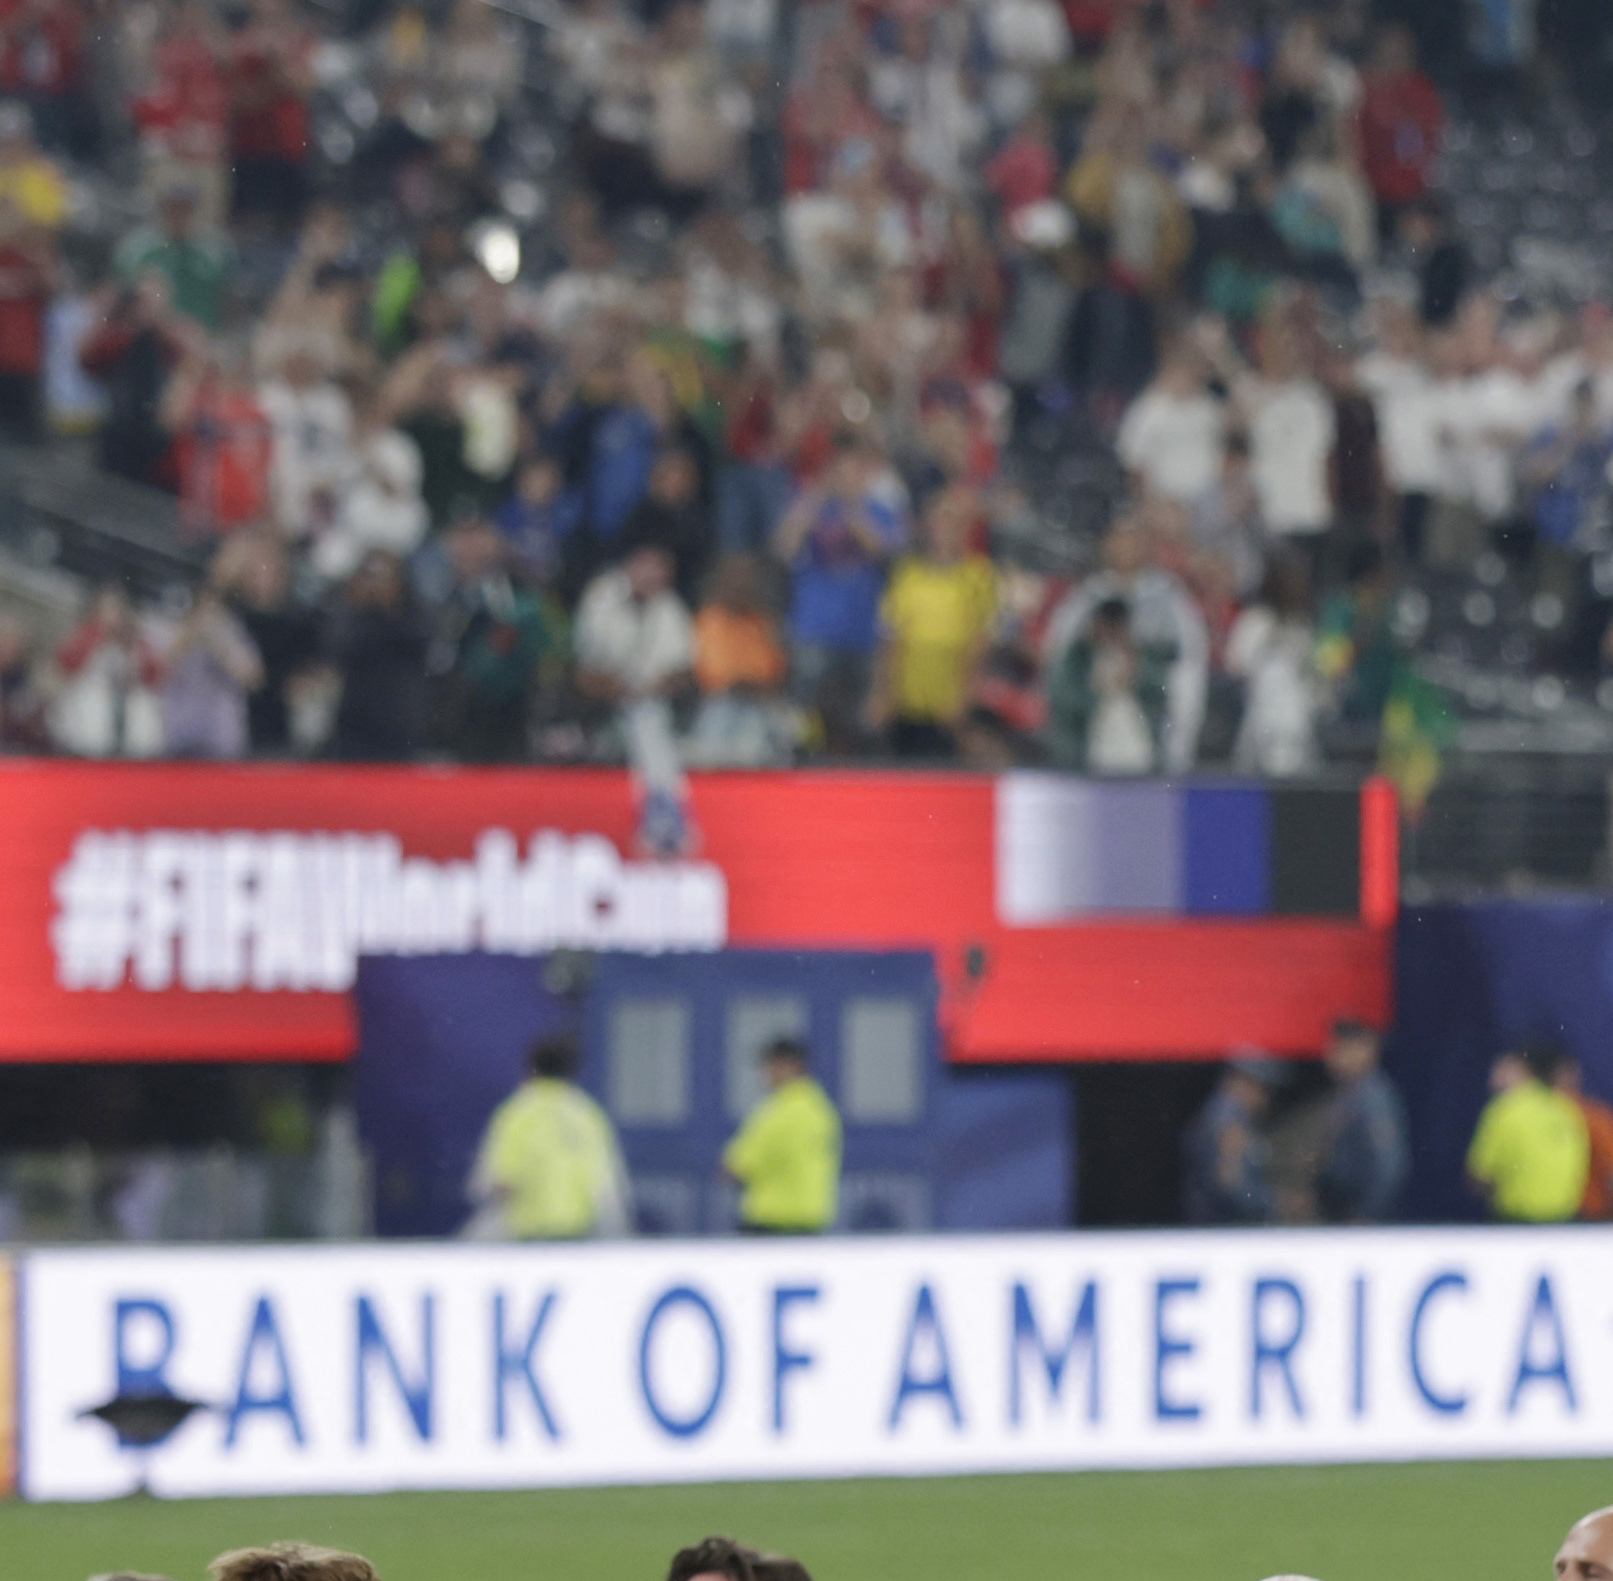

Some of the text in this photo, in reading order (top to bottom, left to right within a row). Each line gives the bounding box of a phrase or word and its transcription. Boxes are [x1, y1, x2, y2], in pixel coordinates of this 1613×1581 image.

[112, 1270, 1579, 1452] BANK OF AMERICA
